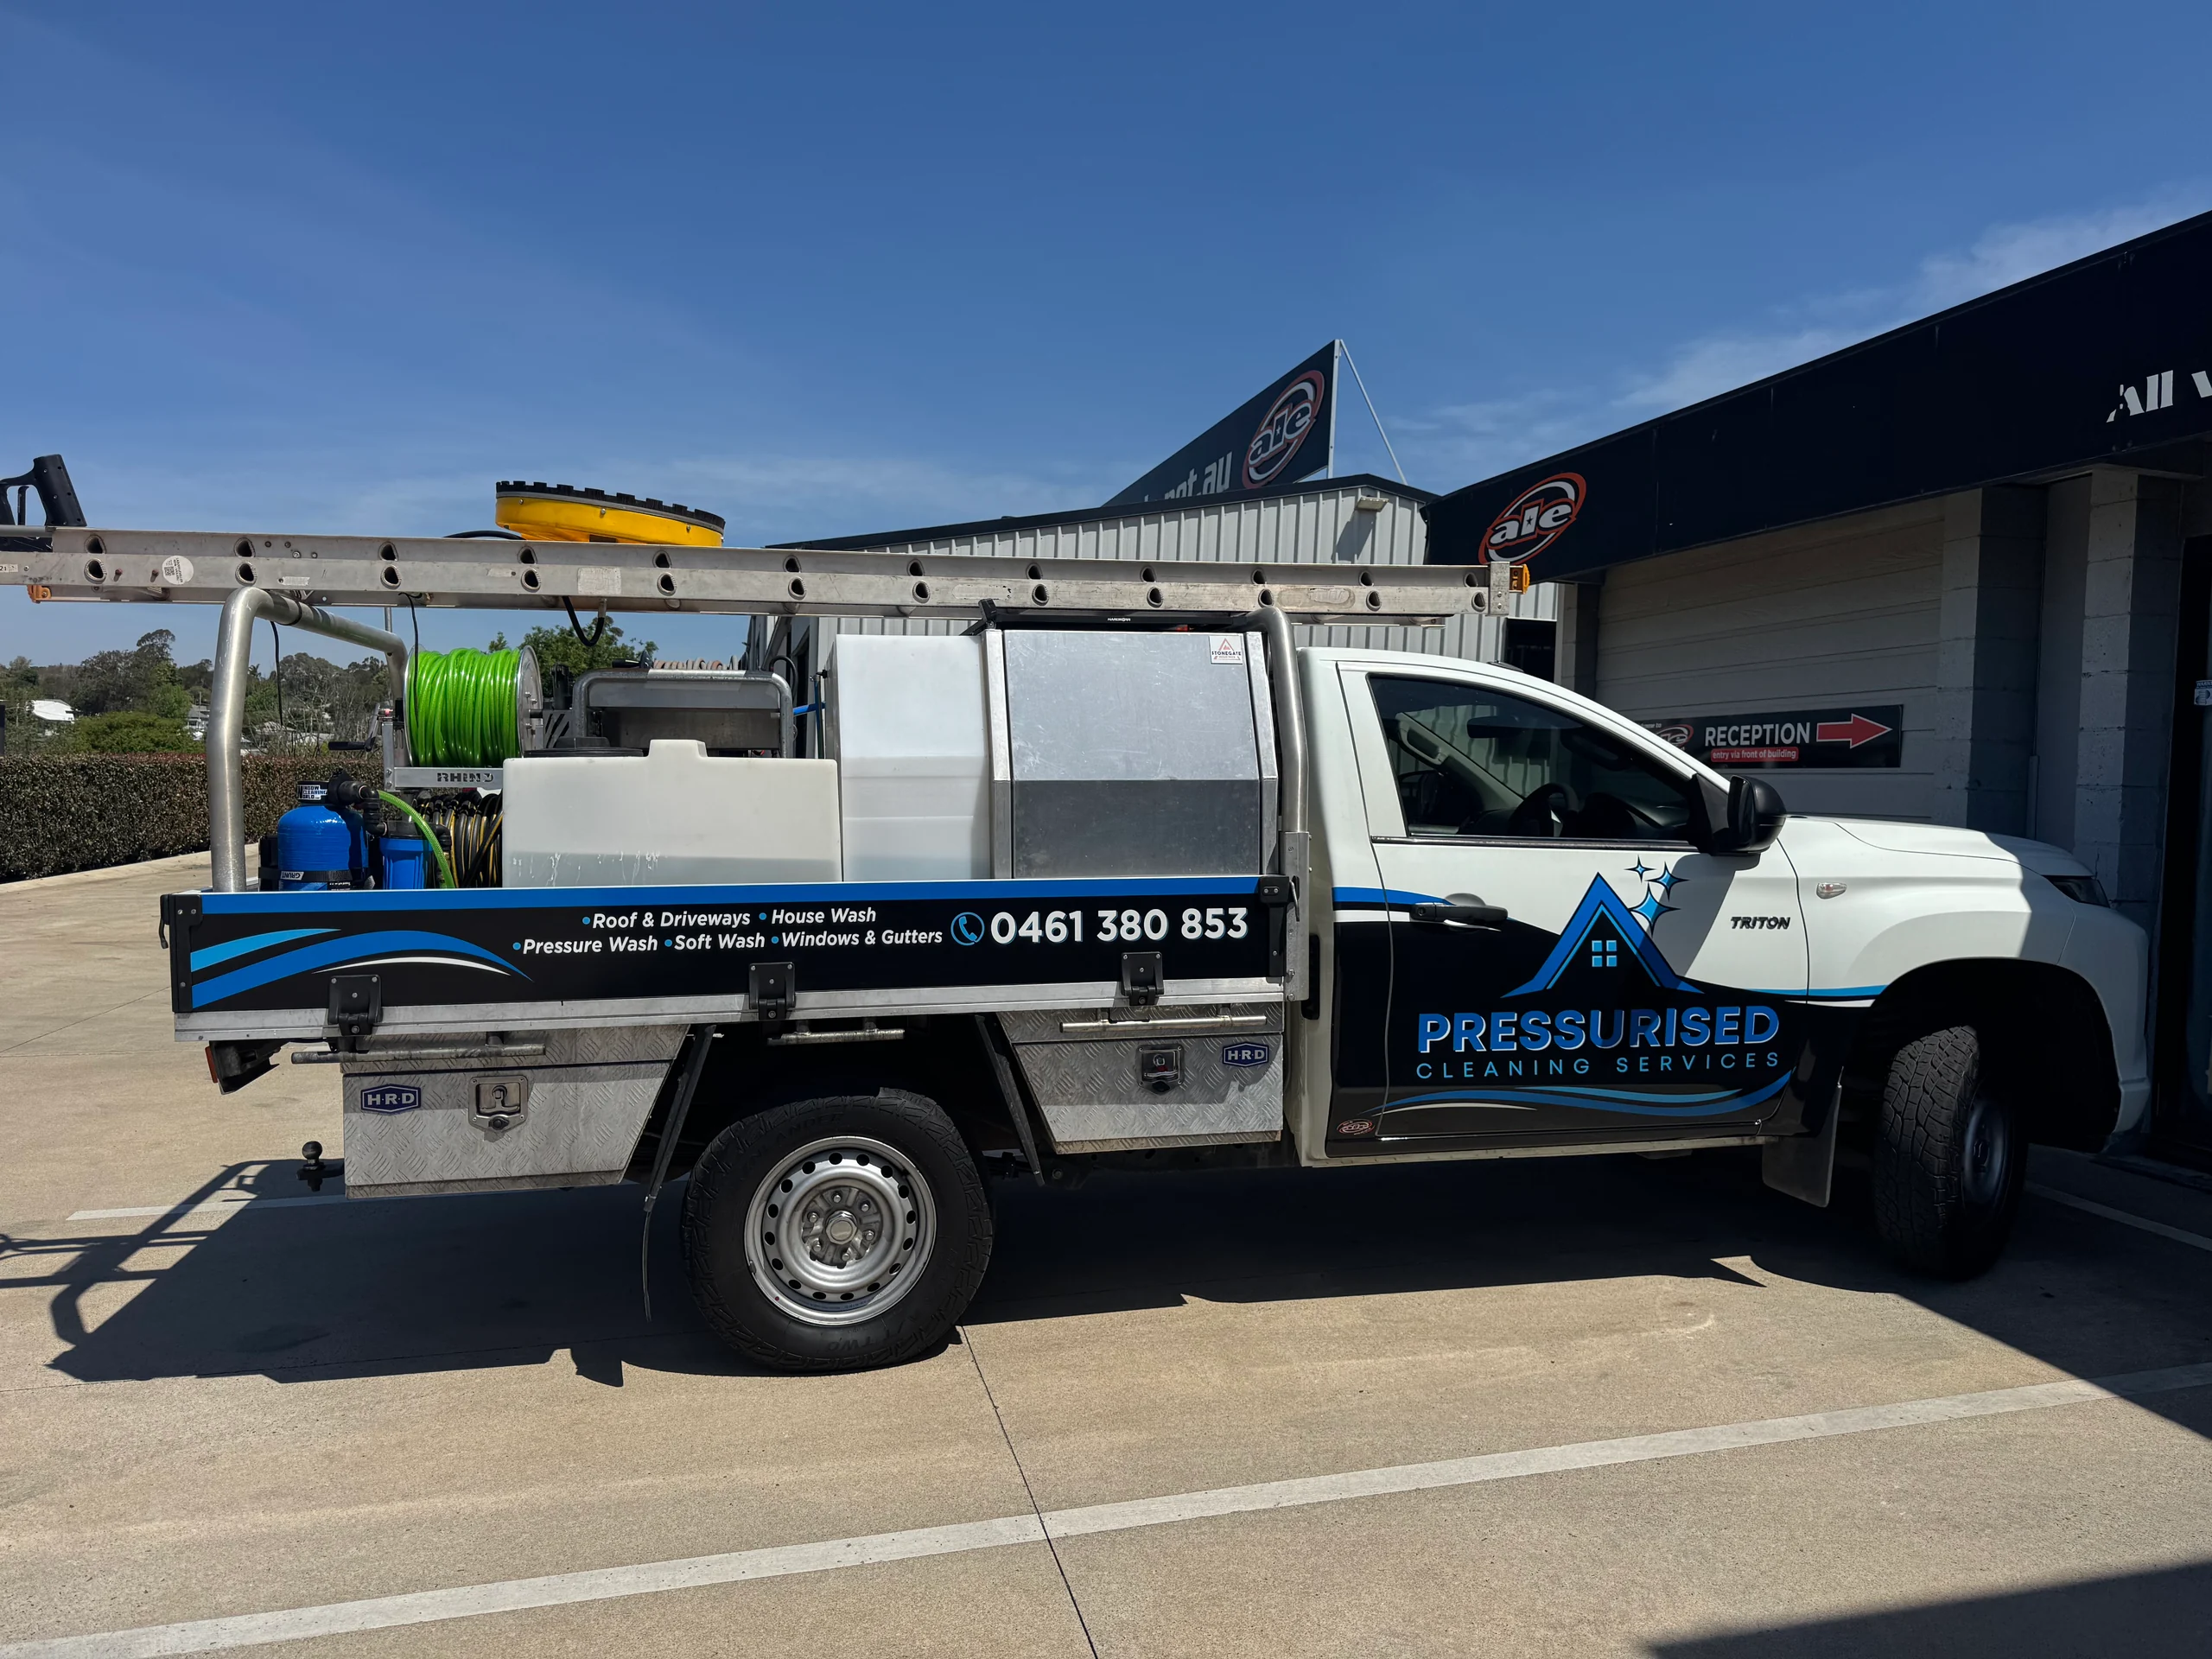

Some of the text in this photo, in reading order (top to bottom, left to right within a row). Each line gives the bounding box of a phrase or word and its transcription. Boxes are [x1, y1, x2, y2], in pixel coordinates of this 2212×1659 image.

[1705, 721, 1811, 747] RECEPTION
[1712, 748, 1796, 760] entry via front of building
[593, 907, 876, 929] Roof & Driveways House Wash
[990, 907, 1249, 944] 0461 380 853
[1731, 916, 1790, 930] TRITON
[523, 929, 943, 955] Pressure Wash Soft Wash Windows & Gutters
[1418, 1005, 1780, 1053] PRESSURISED
[1416, 1052, 1779, 1079] CLEANING SERVICES
